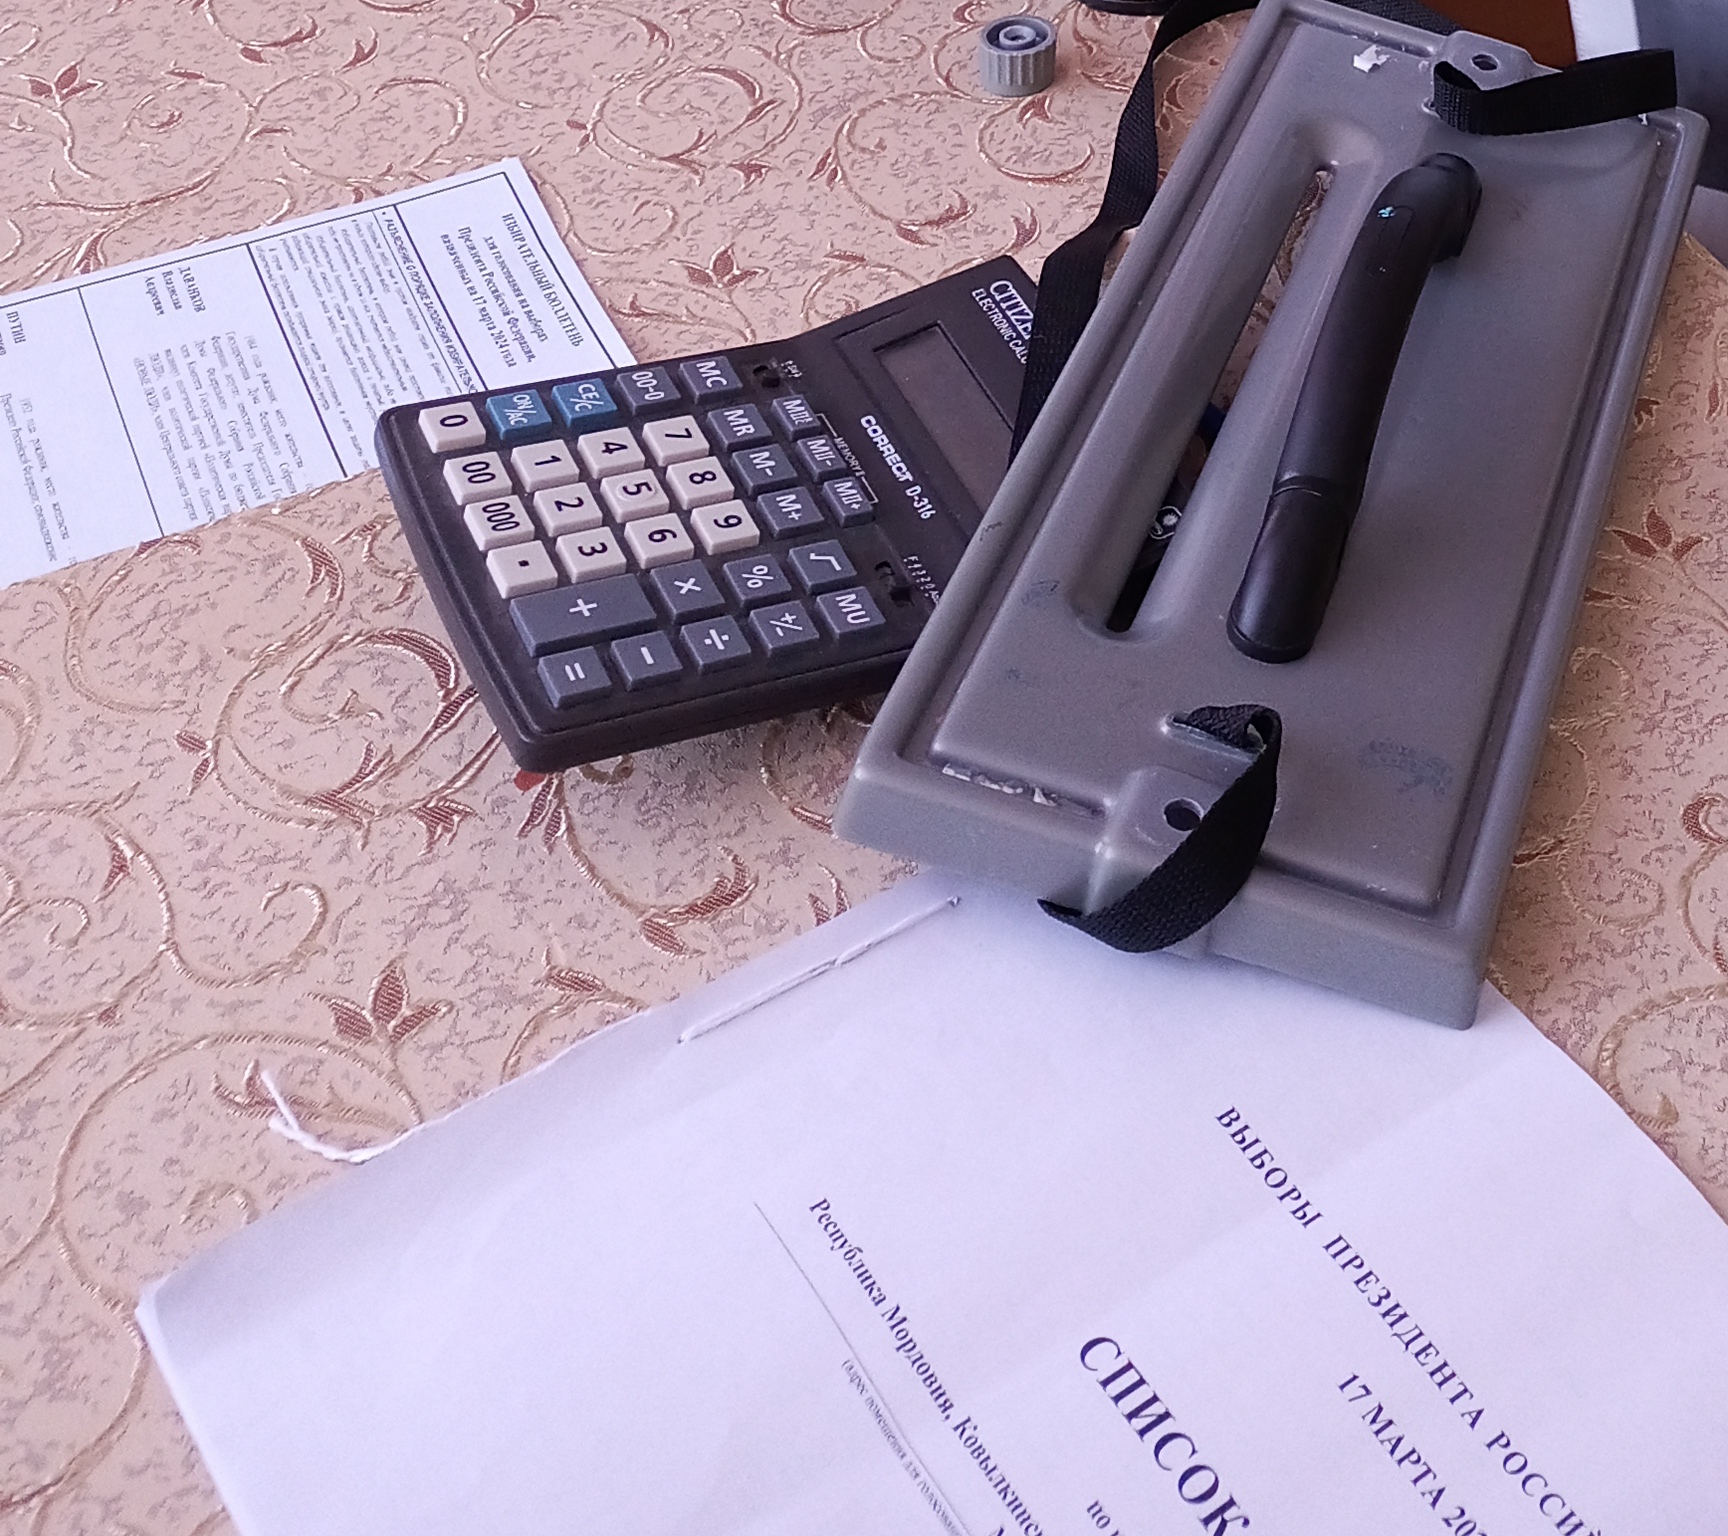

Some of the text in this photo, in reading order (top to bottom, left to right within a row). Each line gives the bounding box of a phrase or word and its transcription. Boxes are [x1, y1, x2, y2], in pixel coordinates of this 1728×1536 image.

[501, 213, 584, 347] ИЗБИРАТЕЛЬНЫЙ БЮЛЛЕТЕНЬ
[6, 311, 26, 344] ПУТИН
[972, 288, 1015, 341] ELECTRONIC
[490, 330, 510, 349] 2024
[631, 371, 665, 401] 00-0
[696, 360, 727, 388] MC
[570, 383, 603, 413] CE/C
[440, 414, 468, 428] 0
[665, 428, 692, 441] 7
[723, 409, 755, 436] MR
[535, 455, 561, 467] 1
[601, 441, 628, 455] 4
[462, 461, 496, 484] 00
[689, 470, 717, 485] 8
[750, 451, 776, 477] M-
[861, 415, 936, 519] CORRECT D-316
[623, 482, 652, 496] 5
[482, 502, 520, 532] 000
[554, 497, 584, 512] 2
[776, 494, 802, 521] M+
[714, 514, 742, 528] 9
[648, 528, 677, 543] 6
[578, 542, 608, 557] 3
[835, 593, 870, 624] MU
[1215, 1106, 1602, 1536] ВЫБОРЫ ПРЕЗИДЕНТА РОССИ
[809, 1198, 1046, 1536] Республика Мордовия, Ковылкинс
[1080, 1337, 1250, 1536] СПИСОК
[1337, 1373, 1372, 1402] 17
[1361, 1402, 1446, 1511] МАРТА
[1087, 1500, 1111, 1529] по
